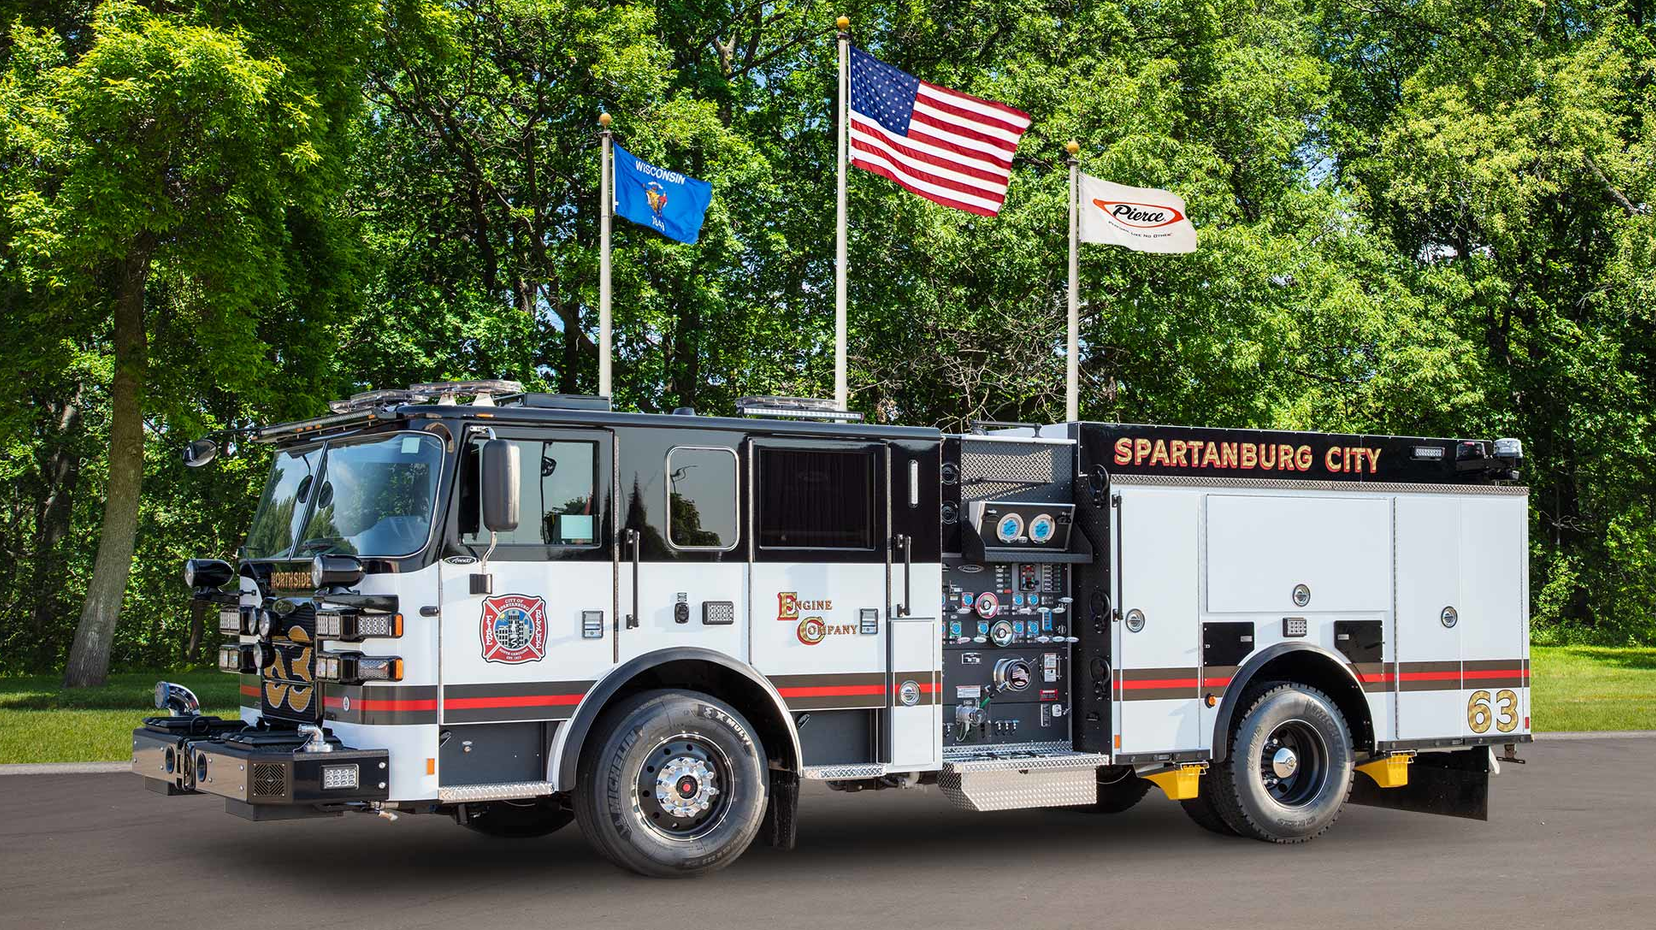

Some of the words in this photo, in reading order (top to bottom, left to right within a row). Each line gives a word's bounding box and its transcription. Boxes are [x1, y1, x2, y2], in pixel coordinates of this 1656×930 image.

[635, 160, 686, 185] WISCONSIN
[1112, 204, 1165, 222] Pierce
[1114, 437, 1313, 470] SPARTANBURG
[1325, 446, 1381, 473] CITY
[271, 571, 312, 589] NORTHSIDE
[1467, 690, 1519, 734] 63
[726, 718, 752, 746] MULTI
[608, 729, 638, 813] MICHELIN
